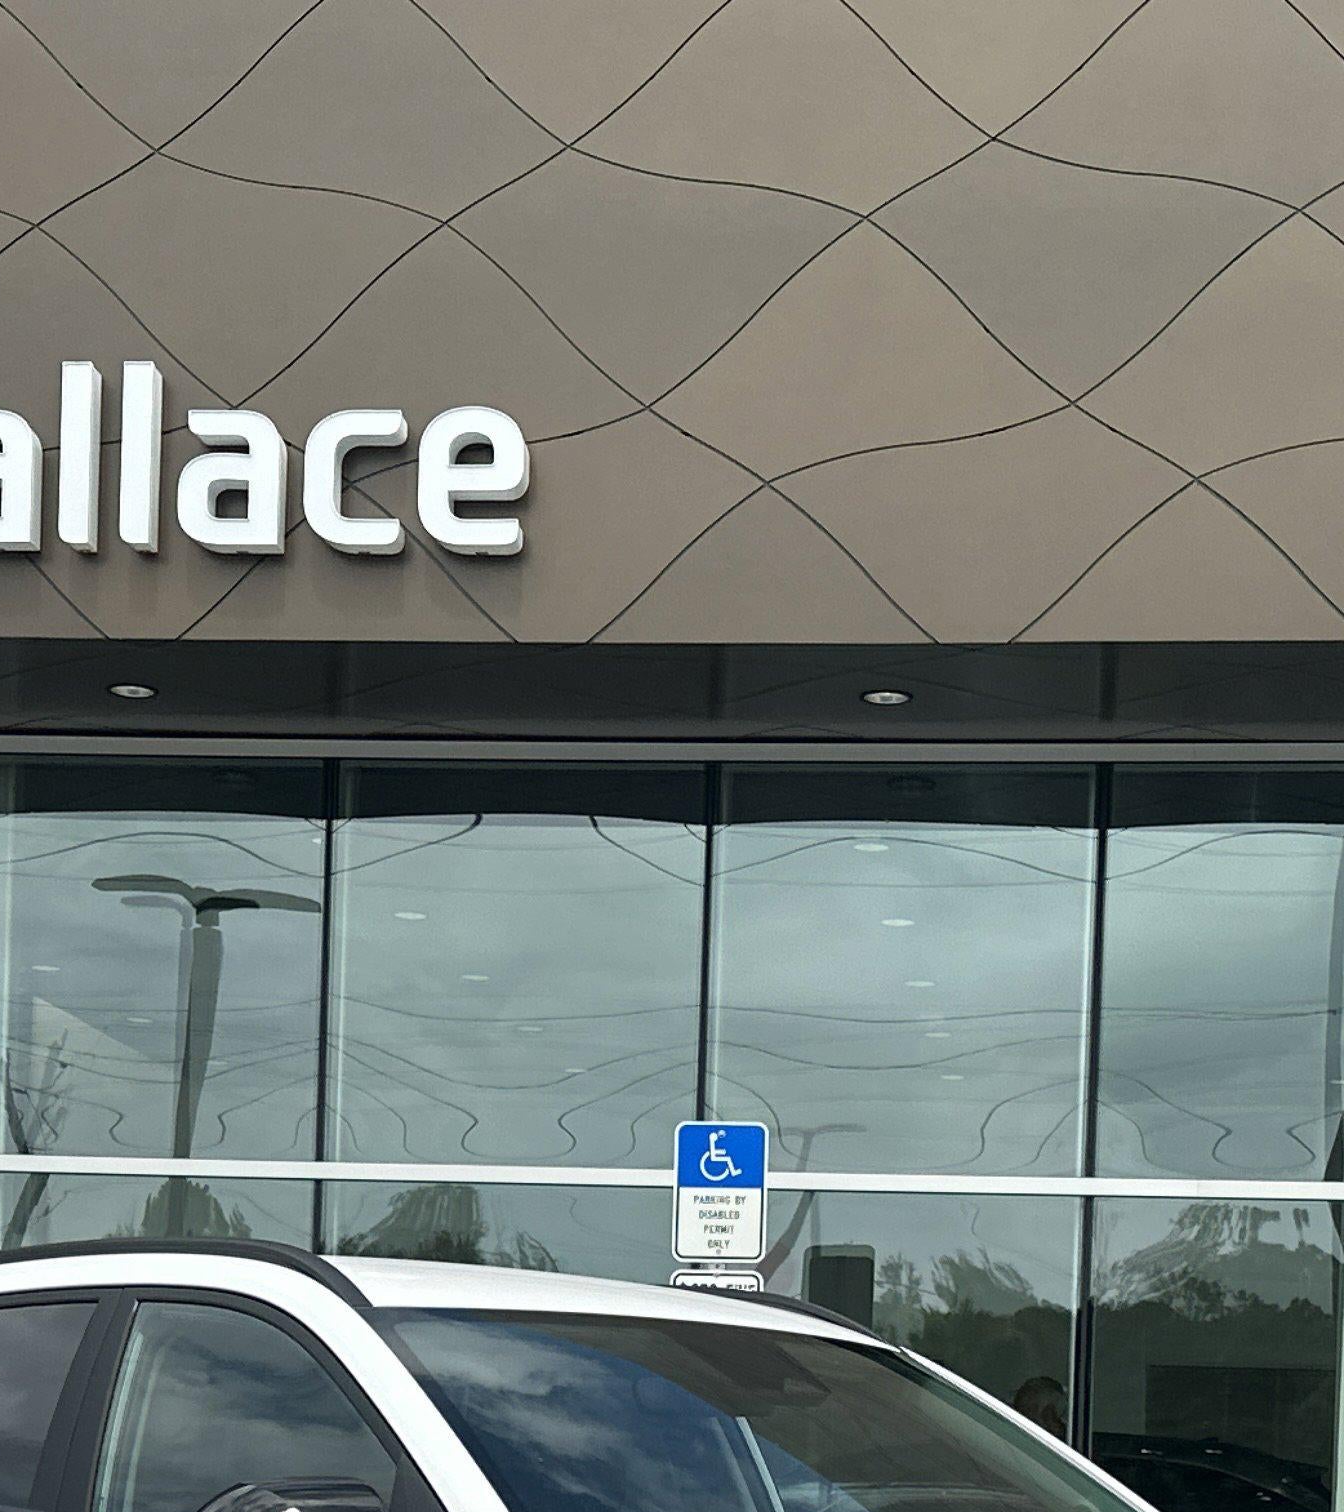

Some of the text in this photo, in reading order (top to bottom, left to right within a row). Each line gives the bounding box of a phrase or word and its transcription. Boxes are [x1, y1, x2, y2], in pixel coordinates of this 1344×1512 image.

[693, 1195, 747, 1205] PARKING BY
[698, 1210, 740, 1220] DISABLED
[703, 1224, 735, 1234] PERMIT
[707, 1239, 731, 1249] ONLY
